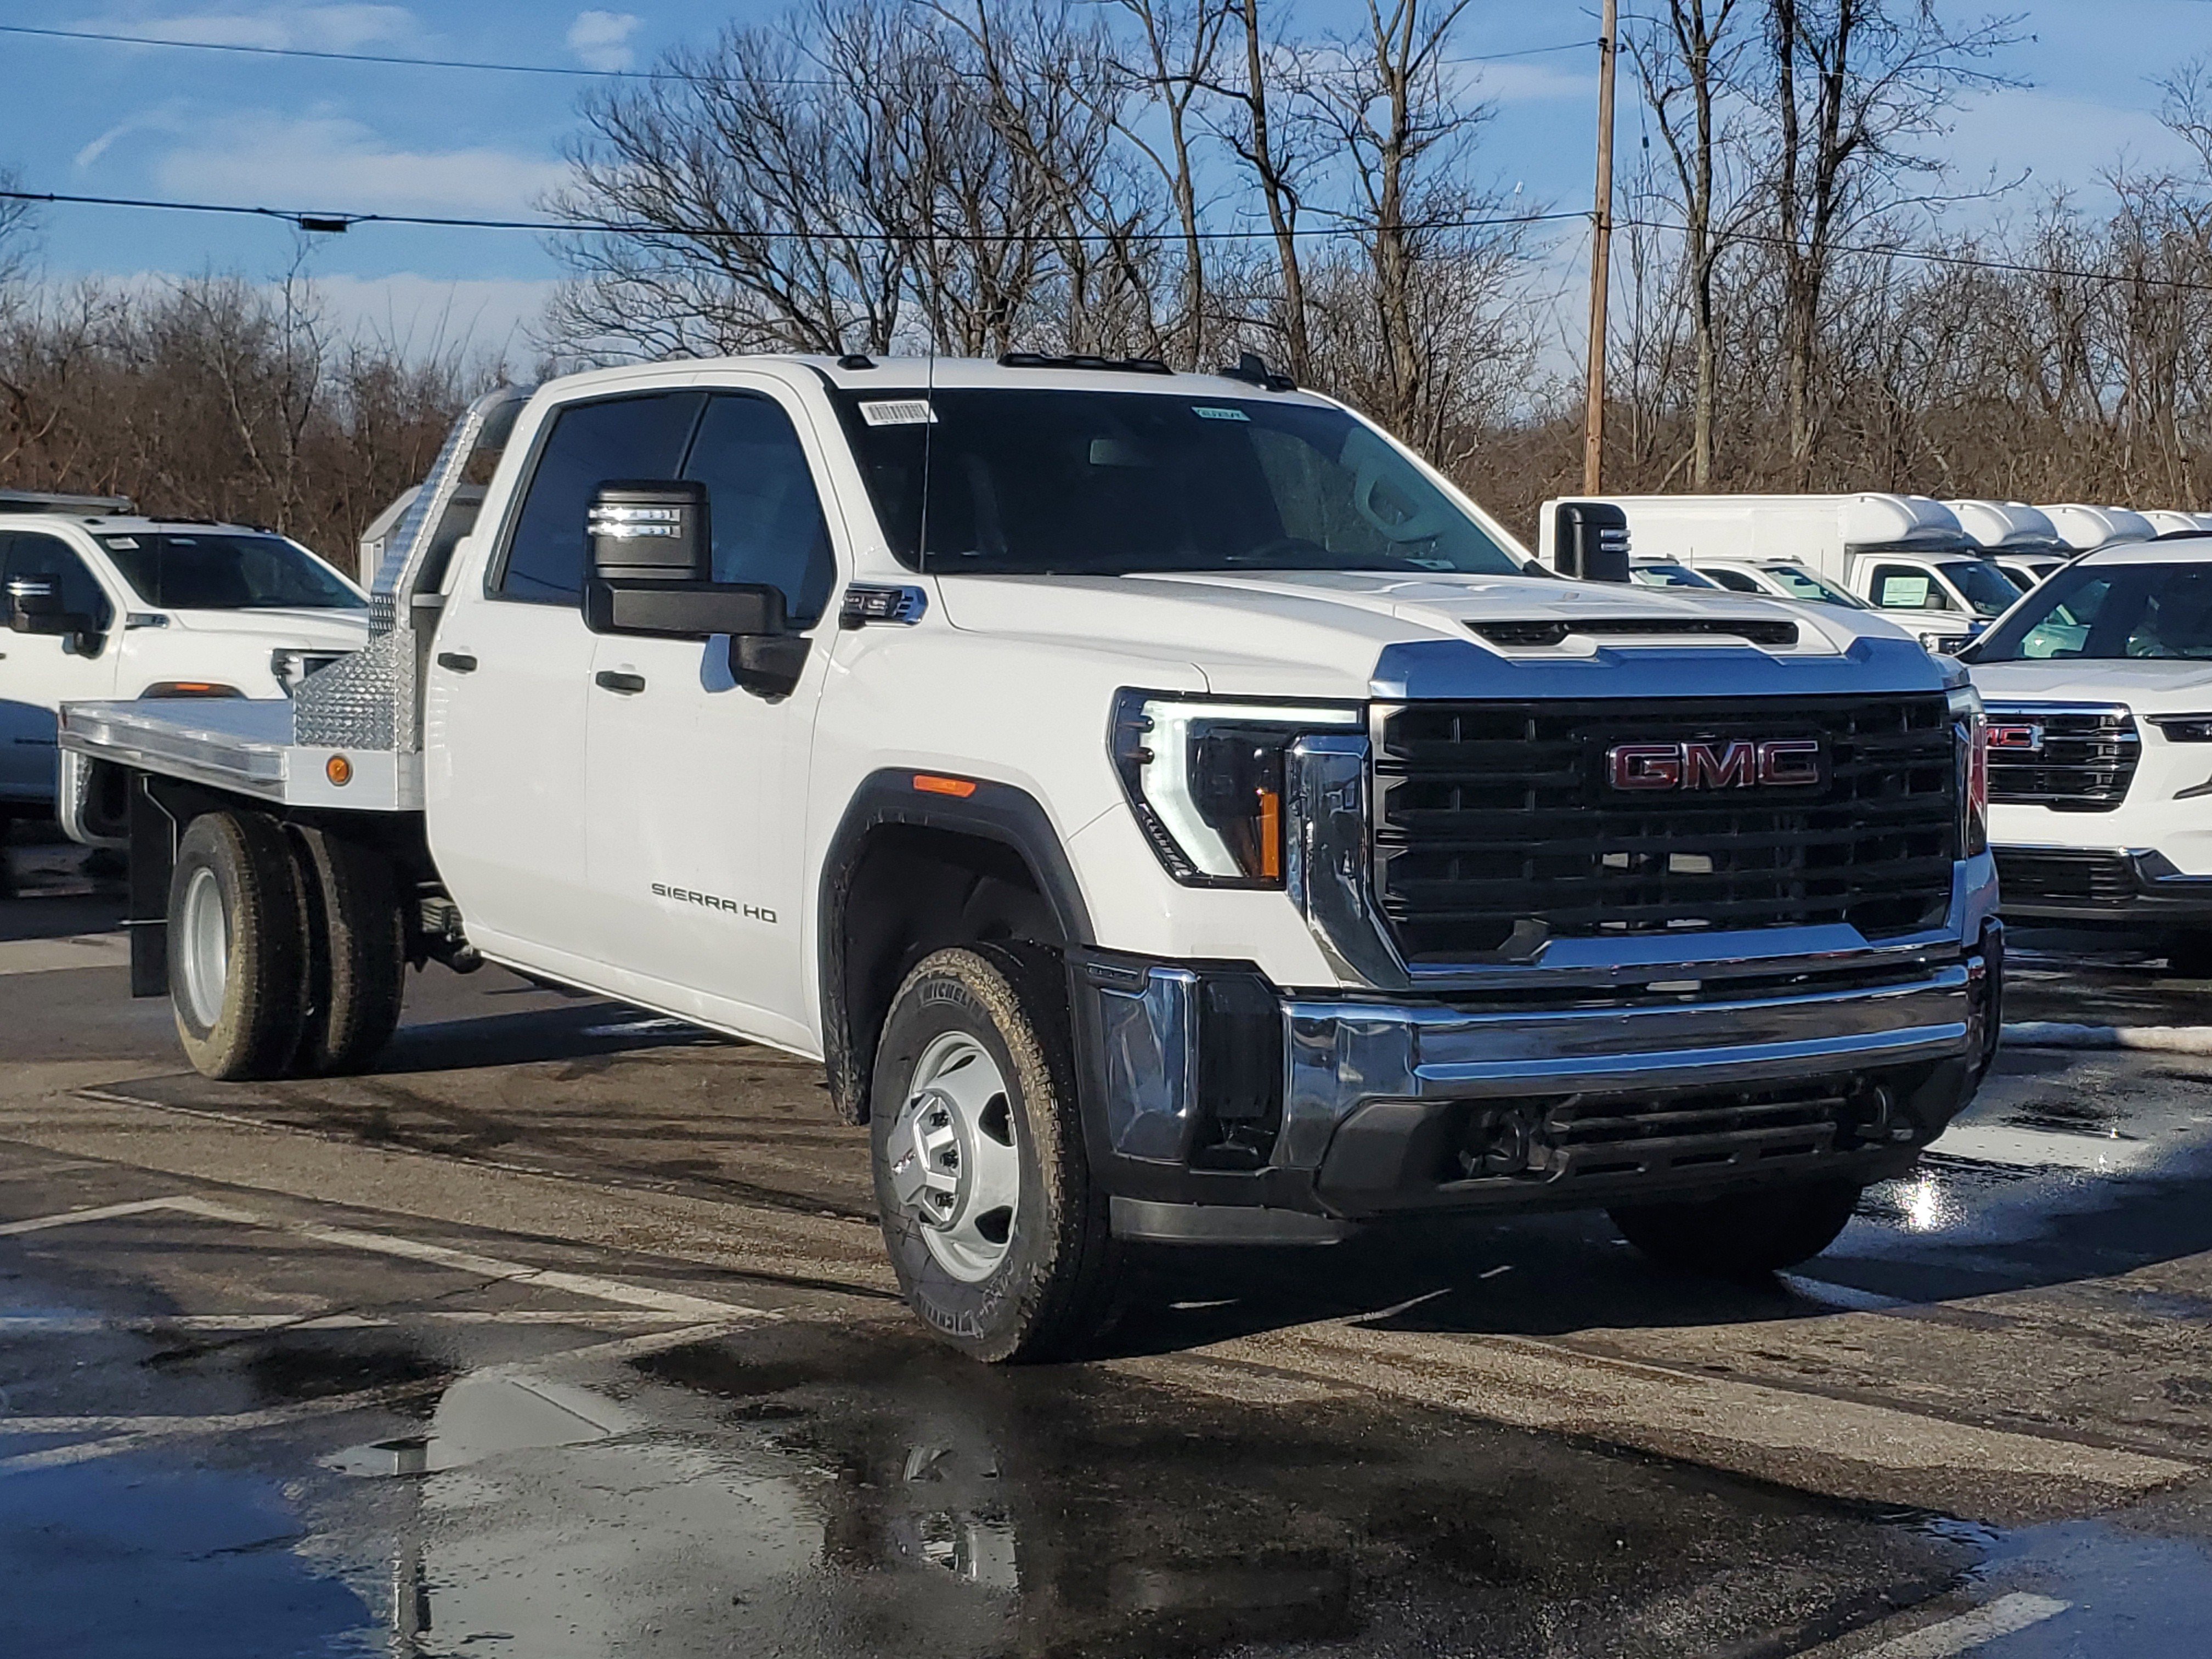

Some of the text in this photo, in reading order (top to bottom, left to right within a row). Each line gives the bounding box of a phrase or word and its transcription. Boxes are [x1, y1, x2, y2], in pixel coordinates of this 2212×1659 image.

[1608, 740, 1819, 791] GMC
[651, 883, 778, 923] SIERRA HD
